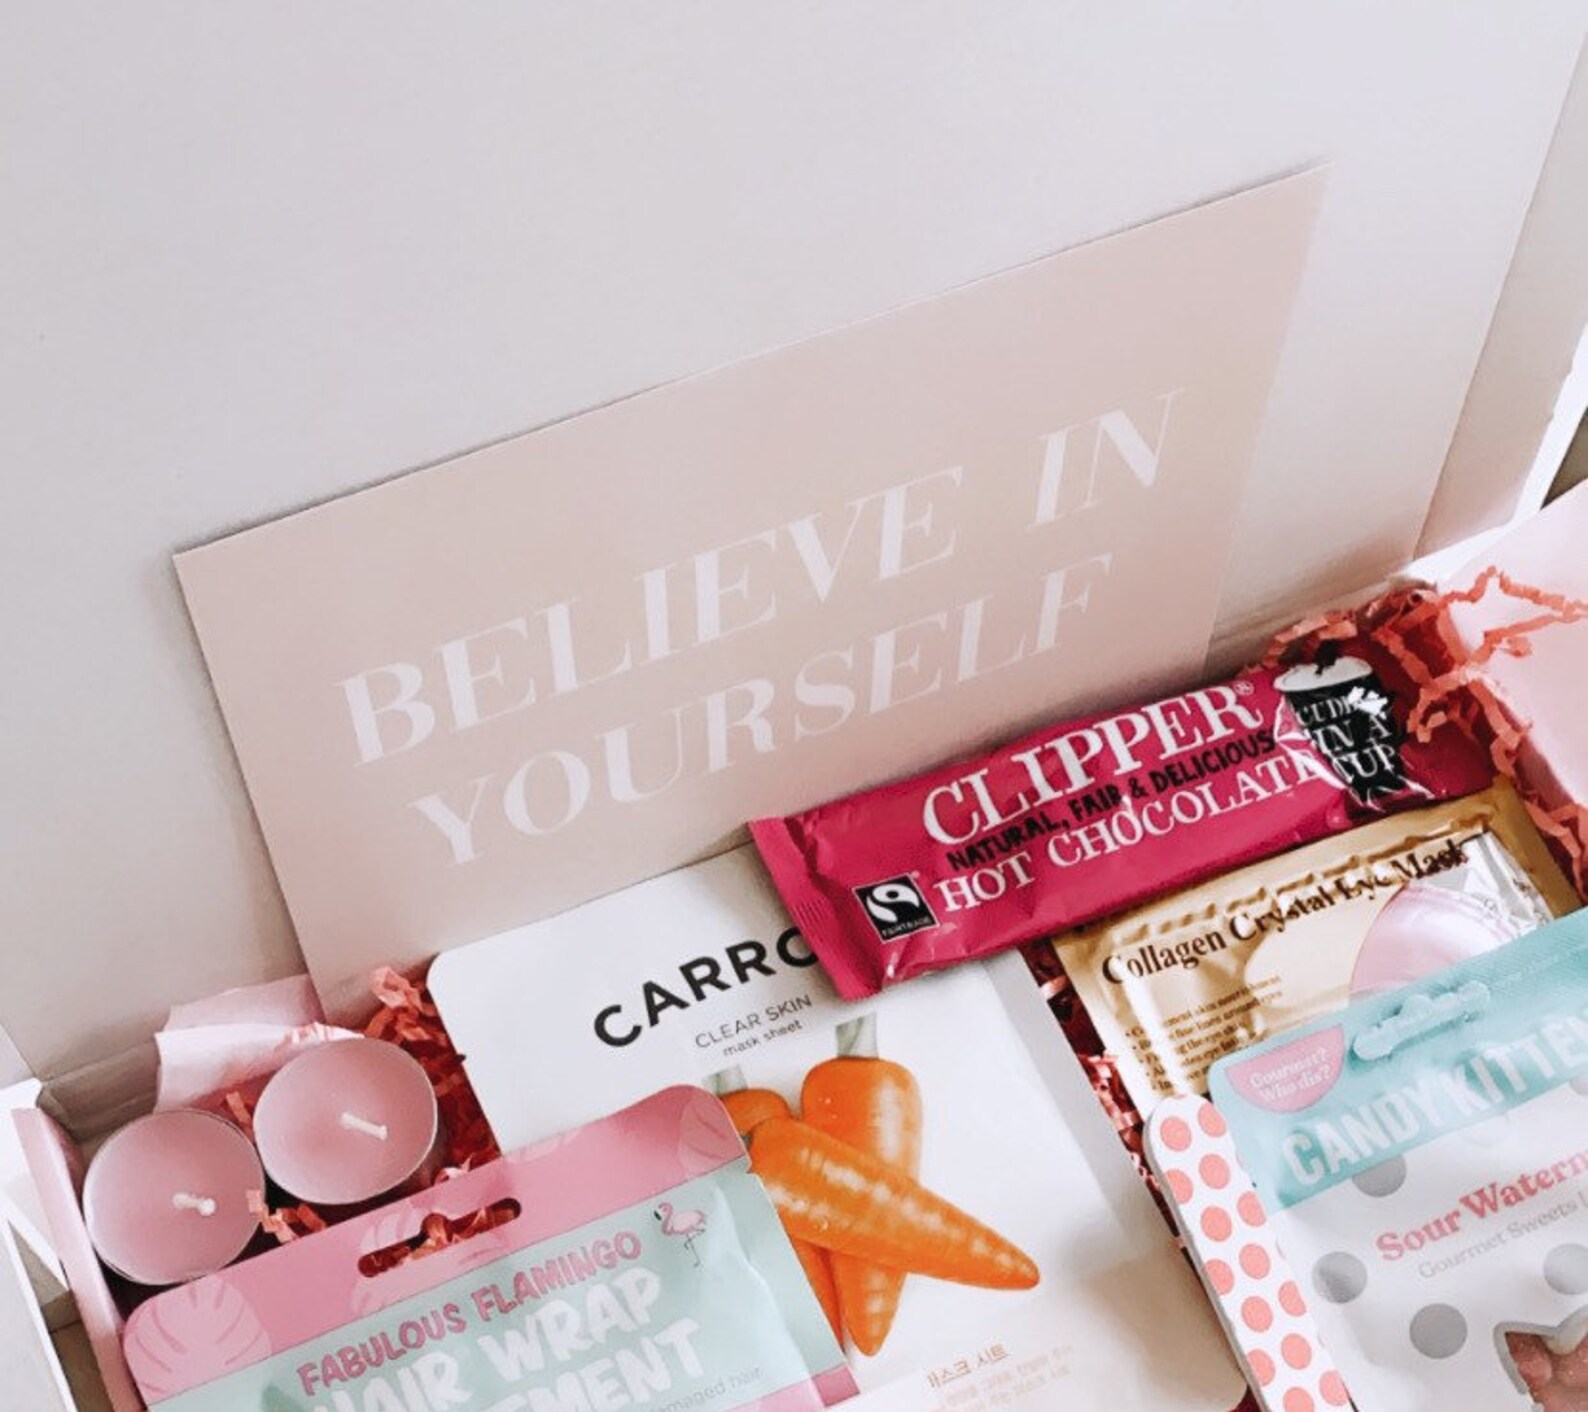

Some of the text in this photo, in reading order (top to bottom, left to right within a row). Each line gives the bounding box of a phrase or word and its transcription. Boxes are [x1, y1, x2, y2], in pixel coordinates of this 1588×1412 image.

[333, 388, 1186, 768] BELIEVE IN
[406, 552, 1115, 868] YOURSELF
[945, 728, 1276, 871] NATURAL, FAIR & DELICIOUS
[934, 851, 1036, 916] HOT
[1101, 928, 1229, 984] Collagen
[1228, 885, 1337, 941] Crystal
[1398, 838, 1470, 880] Mask
[695, 993, 813, 1049] CLEAR SKIN
[722, 1017, 804, 1058] mask sheet
[1376, 1210, 1461, 1261] Sour
[1418, 1201, 1578, 1279] Gourmet Sweets
[297, 1230, 643, 1397] FABULOUS FLAMINGO
[476, 1266, 662, 1383] WRAP
